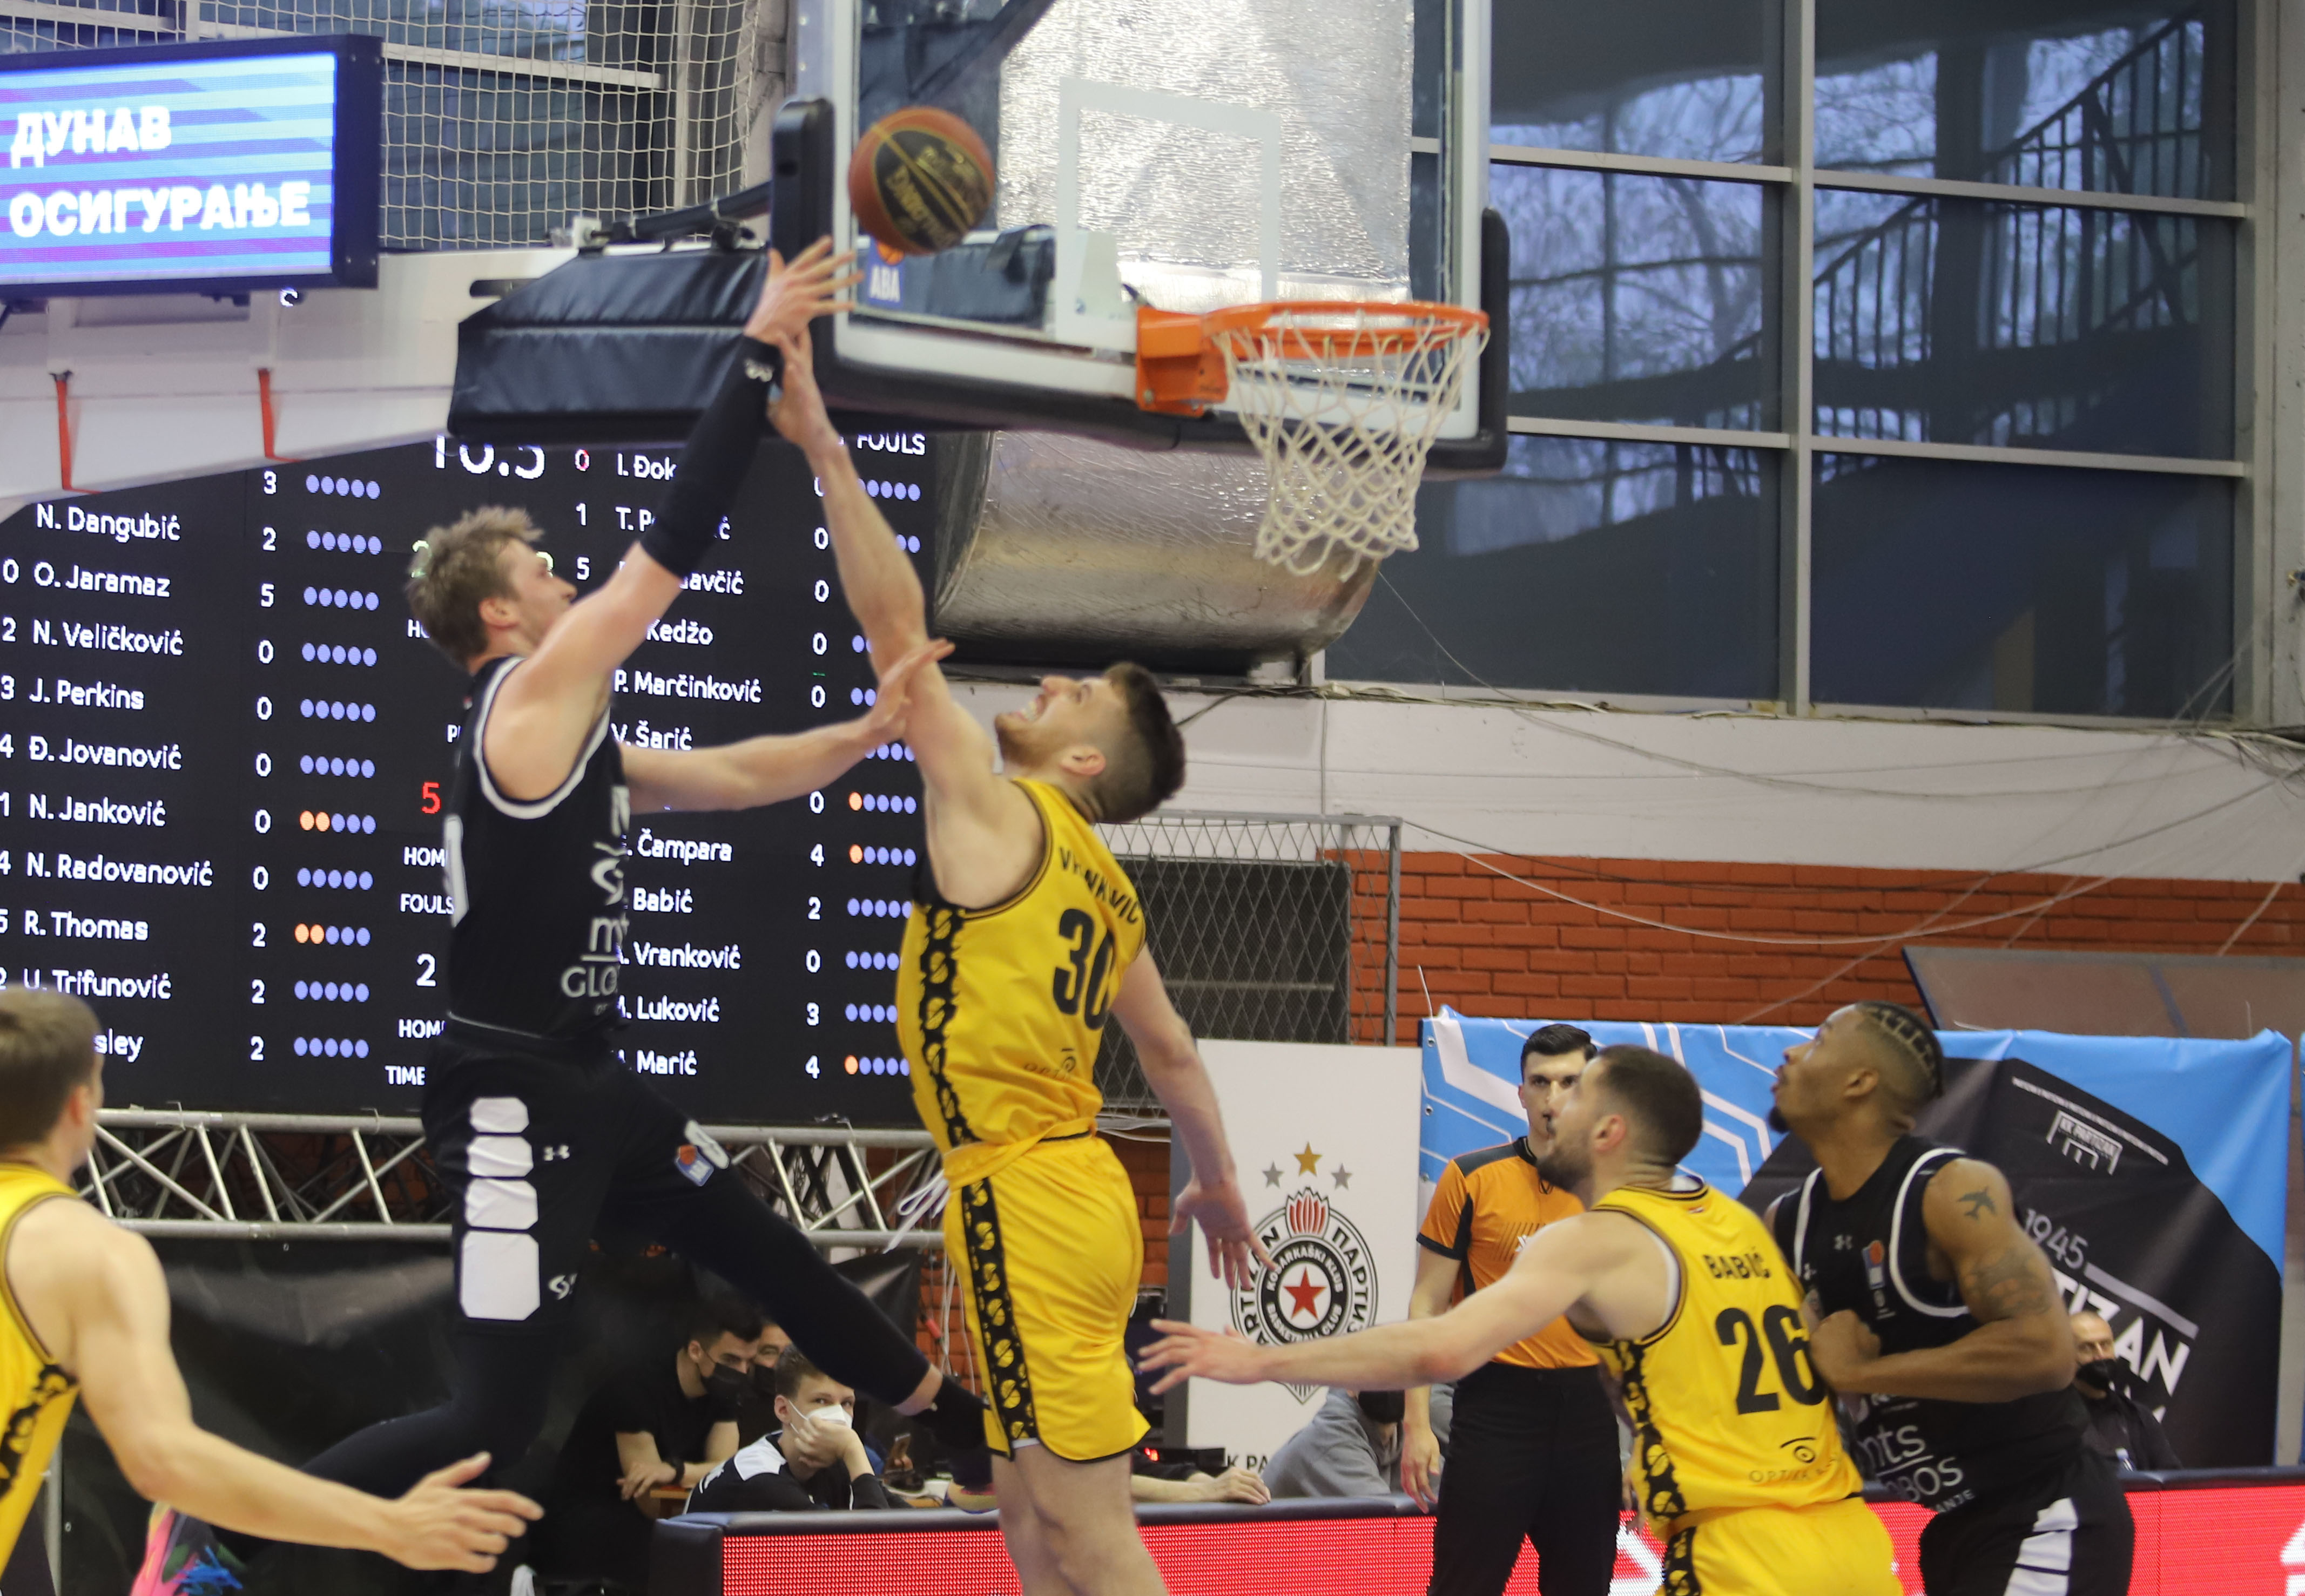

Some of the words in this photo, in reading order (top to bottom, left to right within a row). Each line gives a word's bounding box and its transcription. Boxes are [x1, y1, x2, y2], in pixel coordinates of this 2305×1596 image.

[10, 106, 172, 168] ДУНАВ
[9, 181, 311, 238] ОСИГУРАЊЕ
[857, 432, 925, 455] FOULS
[574, 449, 590, 471] 0
[264, 471, 277, 495] 3
[37, 503, 61, 530] N.
[68, 506, 180, 543] Dangubić
[262, 527, 276, 551] 2
[576, 503, 586, 526] 1
[615, 506, 635, 531] T.
[814, 527, 828, 550] 0
[3, 559, 19, 584] 0
[34, 562, 61, 587] O.
[65, 565, 170, 597] Jaramaz
[261, 583, 274, 607] 5
[577, 557, 590, 580] 5
[679, 570, 744, 594] avčić
[814, 580, 829, 602] 0
[2, 617, 16, 642] 2
[33, 619, 58, 645] N.
[62, 621, 183, 655] Veličković
[258, 640, 274, 664] 0
[813, 632, 827, 655] 0
[1, 675, 15, 700] 3
[29, 678, 50, 703] J.
[57, 679, 144, 709] Perkins
[257, 696, 272, 720] 0
[614, 669, 629, 693] P.
[635, 671, 761, 703] Marčinković
[811, 685, 826, 708] 0
[635, 720, 692, 751] Šarić
[29, 735, 55, 761] Đ.
[59, 738, 181, 769] Jovanović
[256, 753, 271, 777] 0
[30, 794, 54, 819] N.
[58, 796, 166, 826] Janković
[255, 809, 271, 833] 0
[421, 782, 441, 814] 5
[810, 791, 824, 814] 0
[403, 846, 447, 867] HOM
[637, 828, 732, 865] Čampara
[810, 844, 824, 867] 4
[27, 852, 51, 877] N.
[58, 854, 213, 886] Radovanović
[253, 866, 268, 890] 0
[400, 894, 454, 915] FOULS
[633, 887, 693, 913] Babić
[808, 897, 821, 919] 2
[25, 910, 46, 935] R.
[51, 911, 148, 941] Thomas
[253, 923, 266, 947] 2
[416, 953, 436, 986] 2
[633, 941, 740, 969] Vranković
[806, 949, 820, 973] 0
[1053, 908, 1114, 1030] 30
[52, 969, 171, 999] Trifunović
[252, 979, 265, 1004] 2
[637, 995, 719, 1022] Luković
[807, 1003, 819, 1026] 3
[399, 1019, 445, 1038] HOM
[93, 1028, 143, 1063] sley
[251, 1036, 264, 1060] 2
[385, 1065, 426, 1085] TIME
[637, 1050, 697, 1075] Marić
[806, 1056, 820, 1079] 4
[2023, 1207, 2089, 1269] 1945
[1324, 1259, 1344, 1293] KLUB
[1715, 1304, 1827, 1415] 26
[1246, 1455, 1268, 1474] PA
